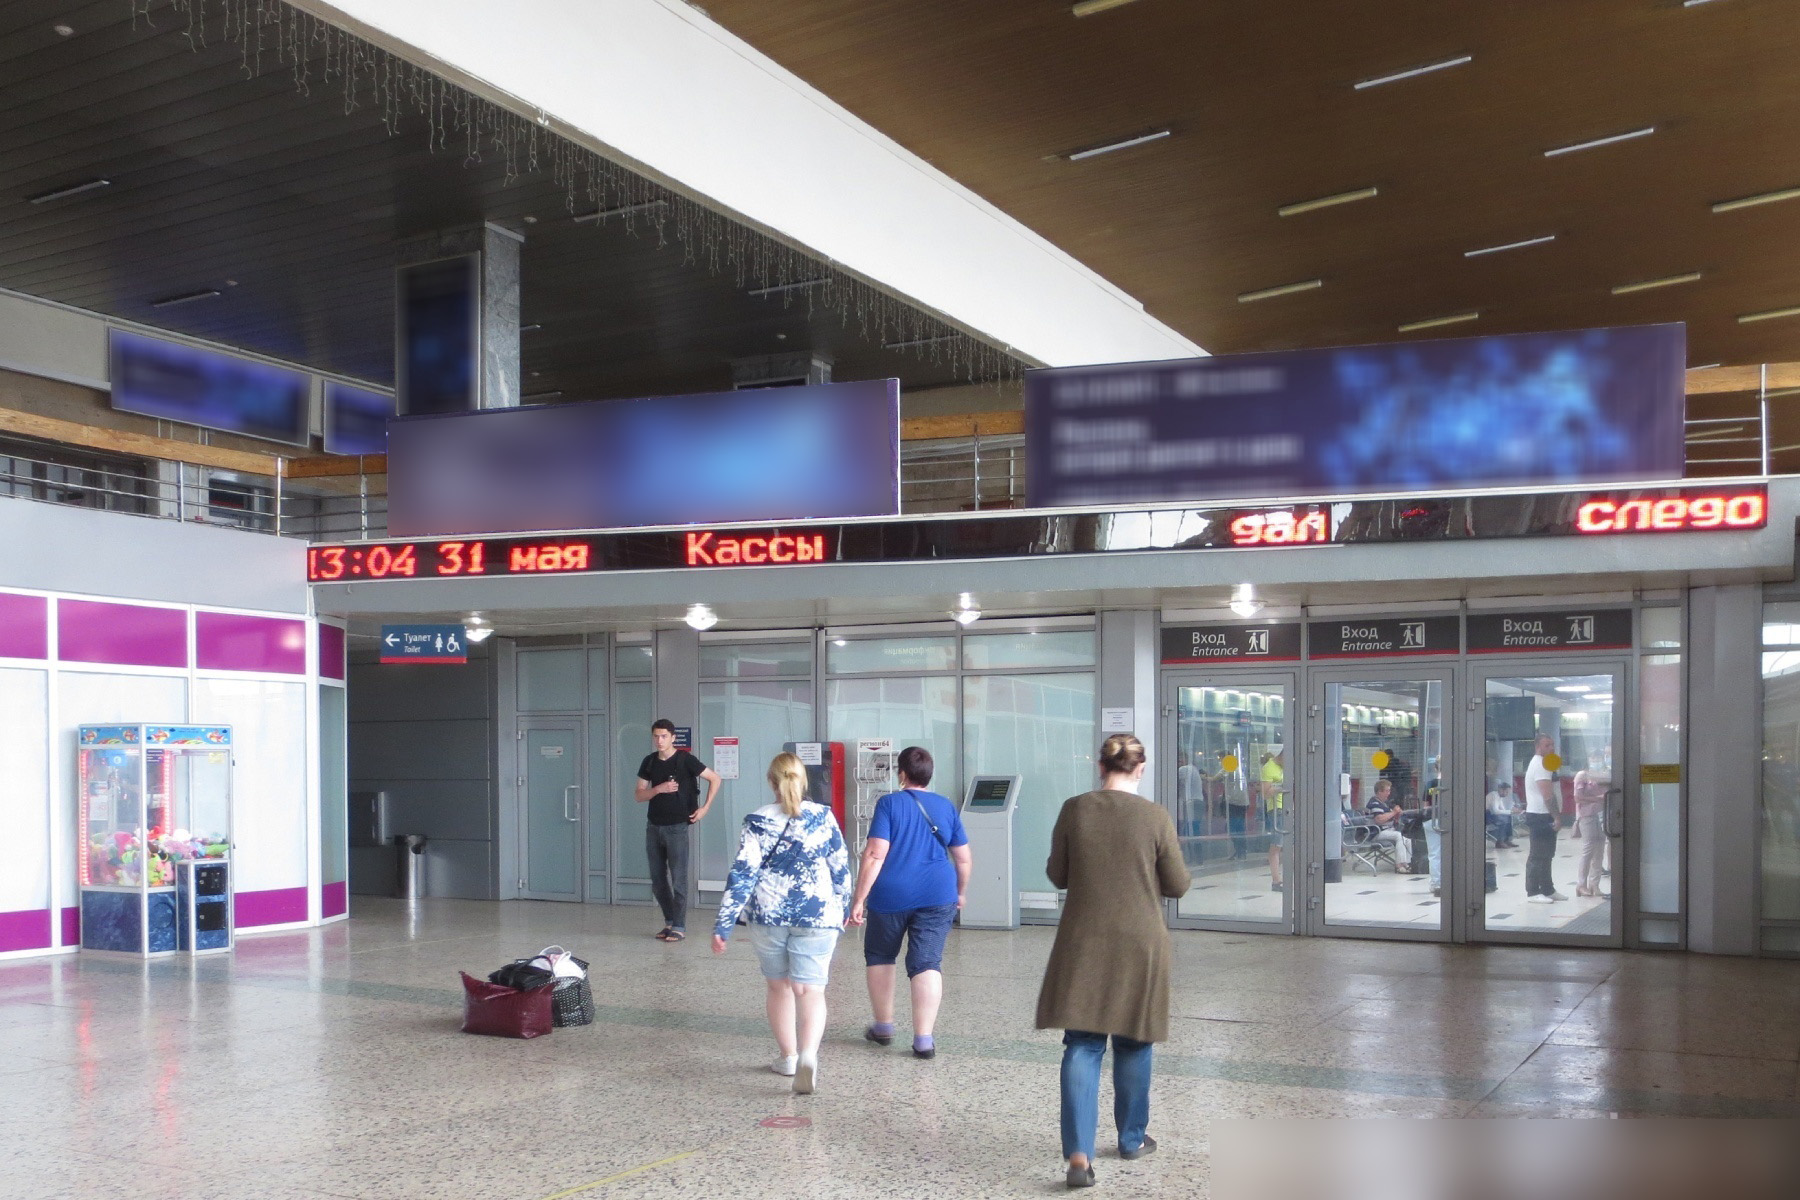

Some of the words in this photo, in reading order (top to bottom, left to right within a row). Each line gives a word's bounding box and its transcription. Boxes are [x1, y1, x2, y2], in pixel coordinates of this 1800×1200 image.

[1576, 494, 1764, 533] следо
[437, 542, 484, 575] 31
[509, 544, 589, 572] мая
[686, 532, 824, 566] Кассы
[1341, 625, 1379, 640] Вход
[1503, 619, 1543, 634] Вход
[403, 633, 432, 644] Туалет
[1192, 632, 1226, 646] Вход
[1503, 634, 1558, 646] Entrance
[1191, 646, 1239, 657] Entrance
[1341, 641, 1393, 652] Entrance
